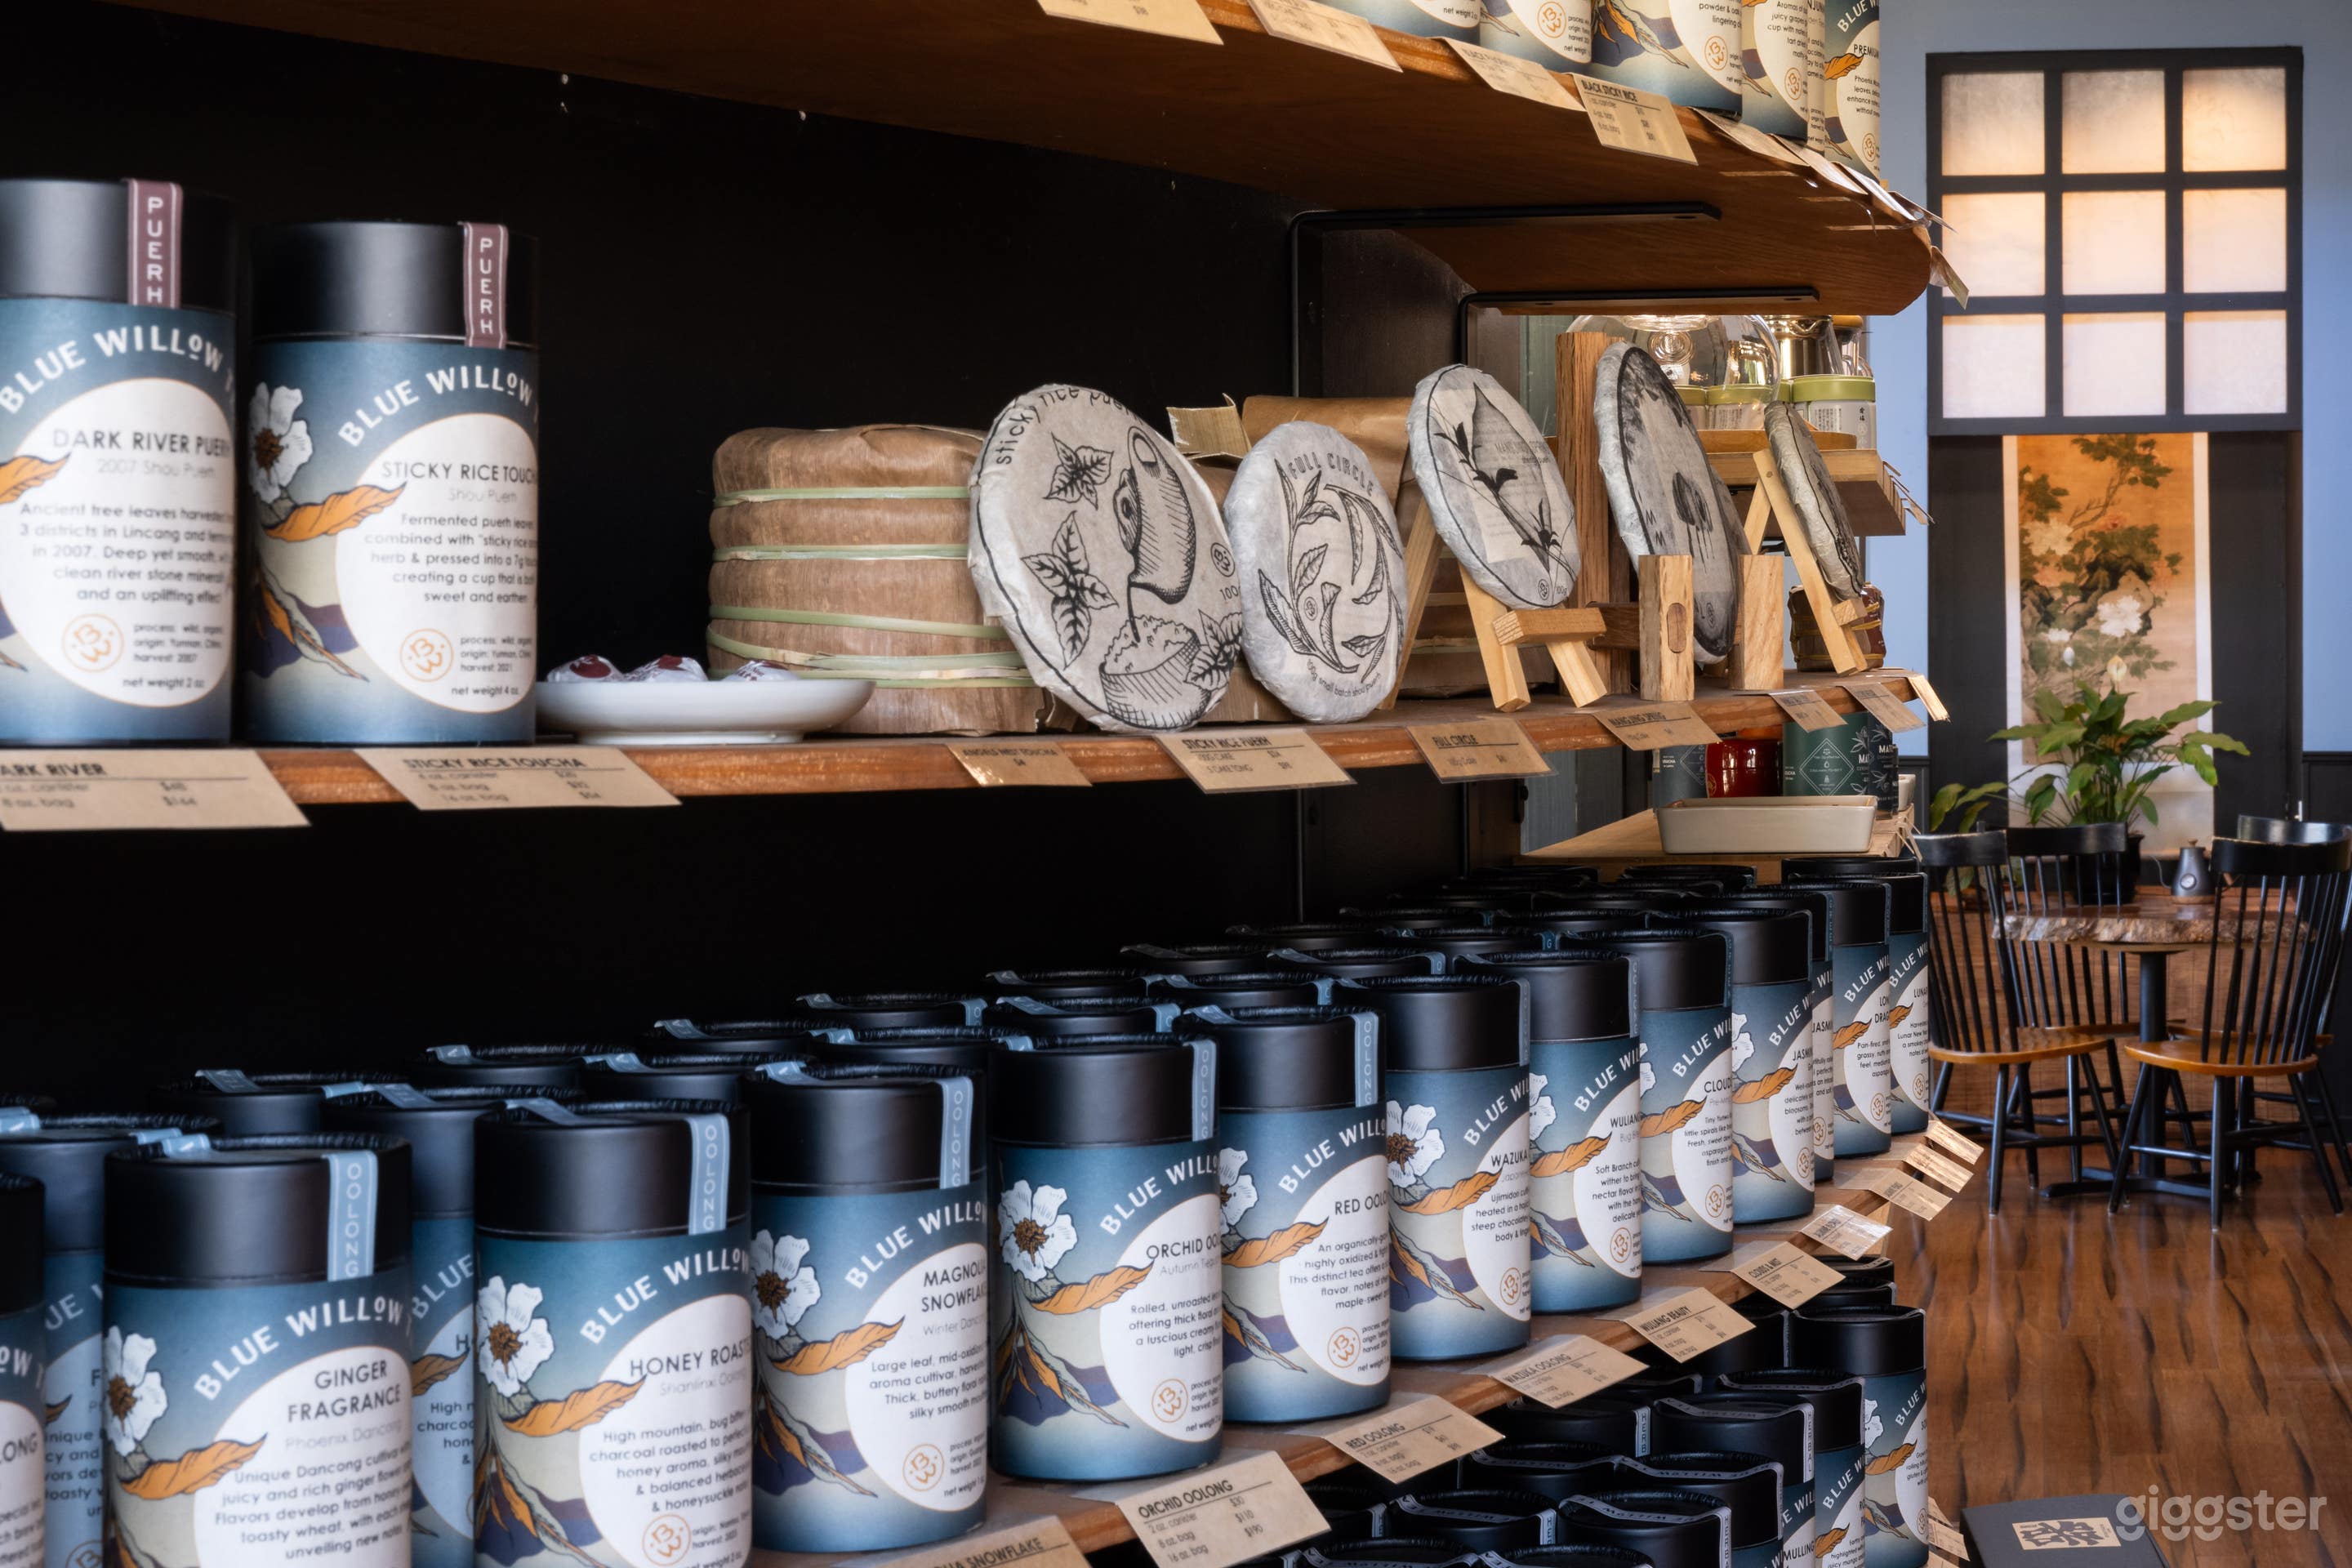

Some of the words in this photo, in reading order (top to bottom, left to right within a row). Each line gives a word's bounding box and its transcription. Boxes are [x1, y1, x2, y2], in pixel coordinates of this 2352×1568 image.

[1699, 2, 1726, 12] powder
[1771, 13, 1787, 22] juicy
[1838, 0, 1869, 33] BLUE
[1713, 16, 1737, 29] lingering
[1767, 24, 1781, 33] cup
[1783, 25, 1794, 33] with
[146, 196, 163, 304] PUERH
[479, 238, 493, 335] PUERH
[0, 341, 85, 416] BLUE
[94, 325, 223, 374] WILLOW
[338, 380, 421, 447] BLUE
[425, 365, 532, 408] WILLOW
[52, 429, 122, 449] DARK
[132, 431, 190, 453] RIVER
[996, 405, 1041, 466] sticky
[381, 461, 452, 480] STICKY
[460, 464, 500, 483] RICE
[1288, 451, 1322, 480] FULL
[1326, 452, 1374, 497] CIRCLE
[21, 503, 86, 516] Ancient
[91, 506, 124, 517] tree
[128, 505, 177, 519] leaves
[401, 513, 478, 527] Fermented
[481, 515, 511, 530] puerh
[34, 523, 98, 538] districts
[102, 525, 118, 539] in
[122, 525, 180, 543] Lincang
[364, 533, 443, 546] combined
[448, 534, 474, 546] with
[102, 546, 148, 561] Deep
[370, 551, 405, 564] herb
[425, 553, 479, 565] pressed
[53, 566, 102, 580] clean
[107, 567, 142, 581] river
[147, 568, 184, 581] stone
[392, 572, 455, 586] creating
[472, 574, 496, 587] cup
[77, 588, 111, 602] and
[116, 589, 137, 602] an
[424, 590, 466, 603] sweet
[470, 591, 494, 604] and
[1182, 738, 1218, 750] STICKY
[1432, 735, 1450, 747] FULL
[1450, 733, 1479, 746] CIRCLE
[46, 762, 108, 777] RIVER
[403, 757, 466, 769] STICKY
[468, 756, 514, 768] RICE
[514, 757, 586, 768] TOUCHA
[1889, 952, 1917, 988] BLUE
[1843, 966, 1876, 1004] BLUE
[1768, 1004, 1802, 1047] BLUE
[1363, 1020, 1373, 1105] OOLONG
[1672, 1032, 1713, 1079] BLUE
[1200, 1049, 1209, 1139] OOLONG
[1574, 1064, 1618, 1113] BLUE
[1463, 1094, 1508, 1147] BLUE
[951, 1089, 964, 1187] OOLONG
[1277, 1138, 1336, 1195] BLUE
[1490, 1150, 1528, 1168] WAZUKA
[1595, 1164, 1610, 1175] Soft
[1611, 1160, 1633, 1174] Branch
[702, 1124, 719, 1232] OOLONG
[1601, 1176, 1623, 1187] wither
[1592, 1190, 1618, 1200] nectar
[1607, 1200, 1622, 1211] with
[1099, 1176, 1162, 1236] BLUE
[1334, 1198, 1361, 1216] RED
[1476, 1206, 1505, 1218] heated
[345, 1162, 363, 1278] OOLONG
[1471, 1222, 1496, 1232] steep
[1494, 1231, 1513, 1243] body
[844, 1225, 915, 1290] BLUE
[1146, 1236, 1204, 1260] ORCHID
[1318, 1242, 1332, 1254] An
[1304, 1258, 1336, 1271] highly
[1339, 1251, 1374, 1267] oxidized
[1289, 1274, 1308, 1285] This
[1312, 1270, 1348, 1283] distinct
[579, 1274, 659, 1346] BLUE
[1170, 1294, 1211, 1311] unroasted
[923, 1321, 959, 1337] Winter
[1129, 1315, 1172, 1330] offering
[1174, 1312, 1196, 1326] thick
[1640, 1315, 1672, 1333] WULIANG
[1670, 1305, 1692, 1321] BEAUTY
[193, 1325, 280, 1401] BLUE
[286, 1295, 404, 1339] WILLOW
[1147, 1329, 1188, 1346] luscious
[314, 1359, 388, 1391] GINGER
[630, 1351, 704, 1378] HONEY
[871, 1358, 908, 1374] Large
[1503, 1365, 1538, 1384] WAZUKA
[1535, 1352, 1572, 1374] OOLONG
[869, 1375, 911, 1390] aroma
[924, 1383, 960, 1401] buttery
[287, 1383, 402, 1423] FRAGRANCE
[430, 1401, 464, 1417] High
[909, 1404, 933, 1420] silky
[937, 1398, 971, 1415] smooth
[1894, 1391, 1921, 1427] BLUE
[603, 1430, 636, 1445] High
[1345, 1437, 1367, 1450] RED
[1365, 1423, 1406, 1442] OOLONG
[69, 1448, 100, 1461] and
[589, 1446, 656, 1463] charcoal
[659, 1438, 707, 1455] roasted
[234, 1468, 292, 1486] Unique
[296, 1458, 363, 1479] Dancong
[616, 1464, 662, 1480] honey
[221, 1490, 261, 1508] juicy
[265, 1486, 299, 1503] and
[302, 1482, 332, 1499] rich
[334, 1475, 376, 1495] ginger
[635, 1484, 645, 1496] &
[650, 1474, 713, 1494] balanced
[1822, 1469, 1854, 1510] BLUE
[652, 1501, 661, 1512] &
[1138, 1495, 1183, 1519] ORCHID
[1183, 1480, 1234, 1506] OOLONG
[215, 1509, 271, 1526] Flavors
[275, 1503, 341, 1522] develop
[342, 1496, 372, 1512] from
[240, 1529, 291, 1545] toasty
[349, 1515, 375, 1530] with
[1178, 1530, 1196, 1544] bag
[285, 1539, 353, 1560] unveiling
[355, 1533, 381, 1548] new
[965, 1536, 1048, 1568] SNOWFLAKE
[1192, 1544, 1209, 1558] bag
